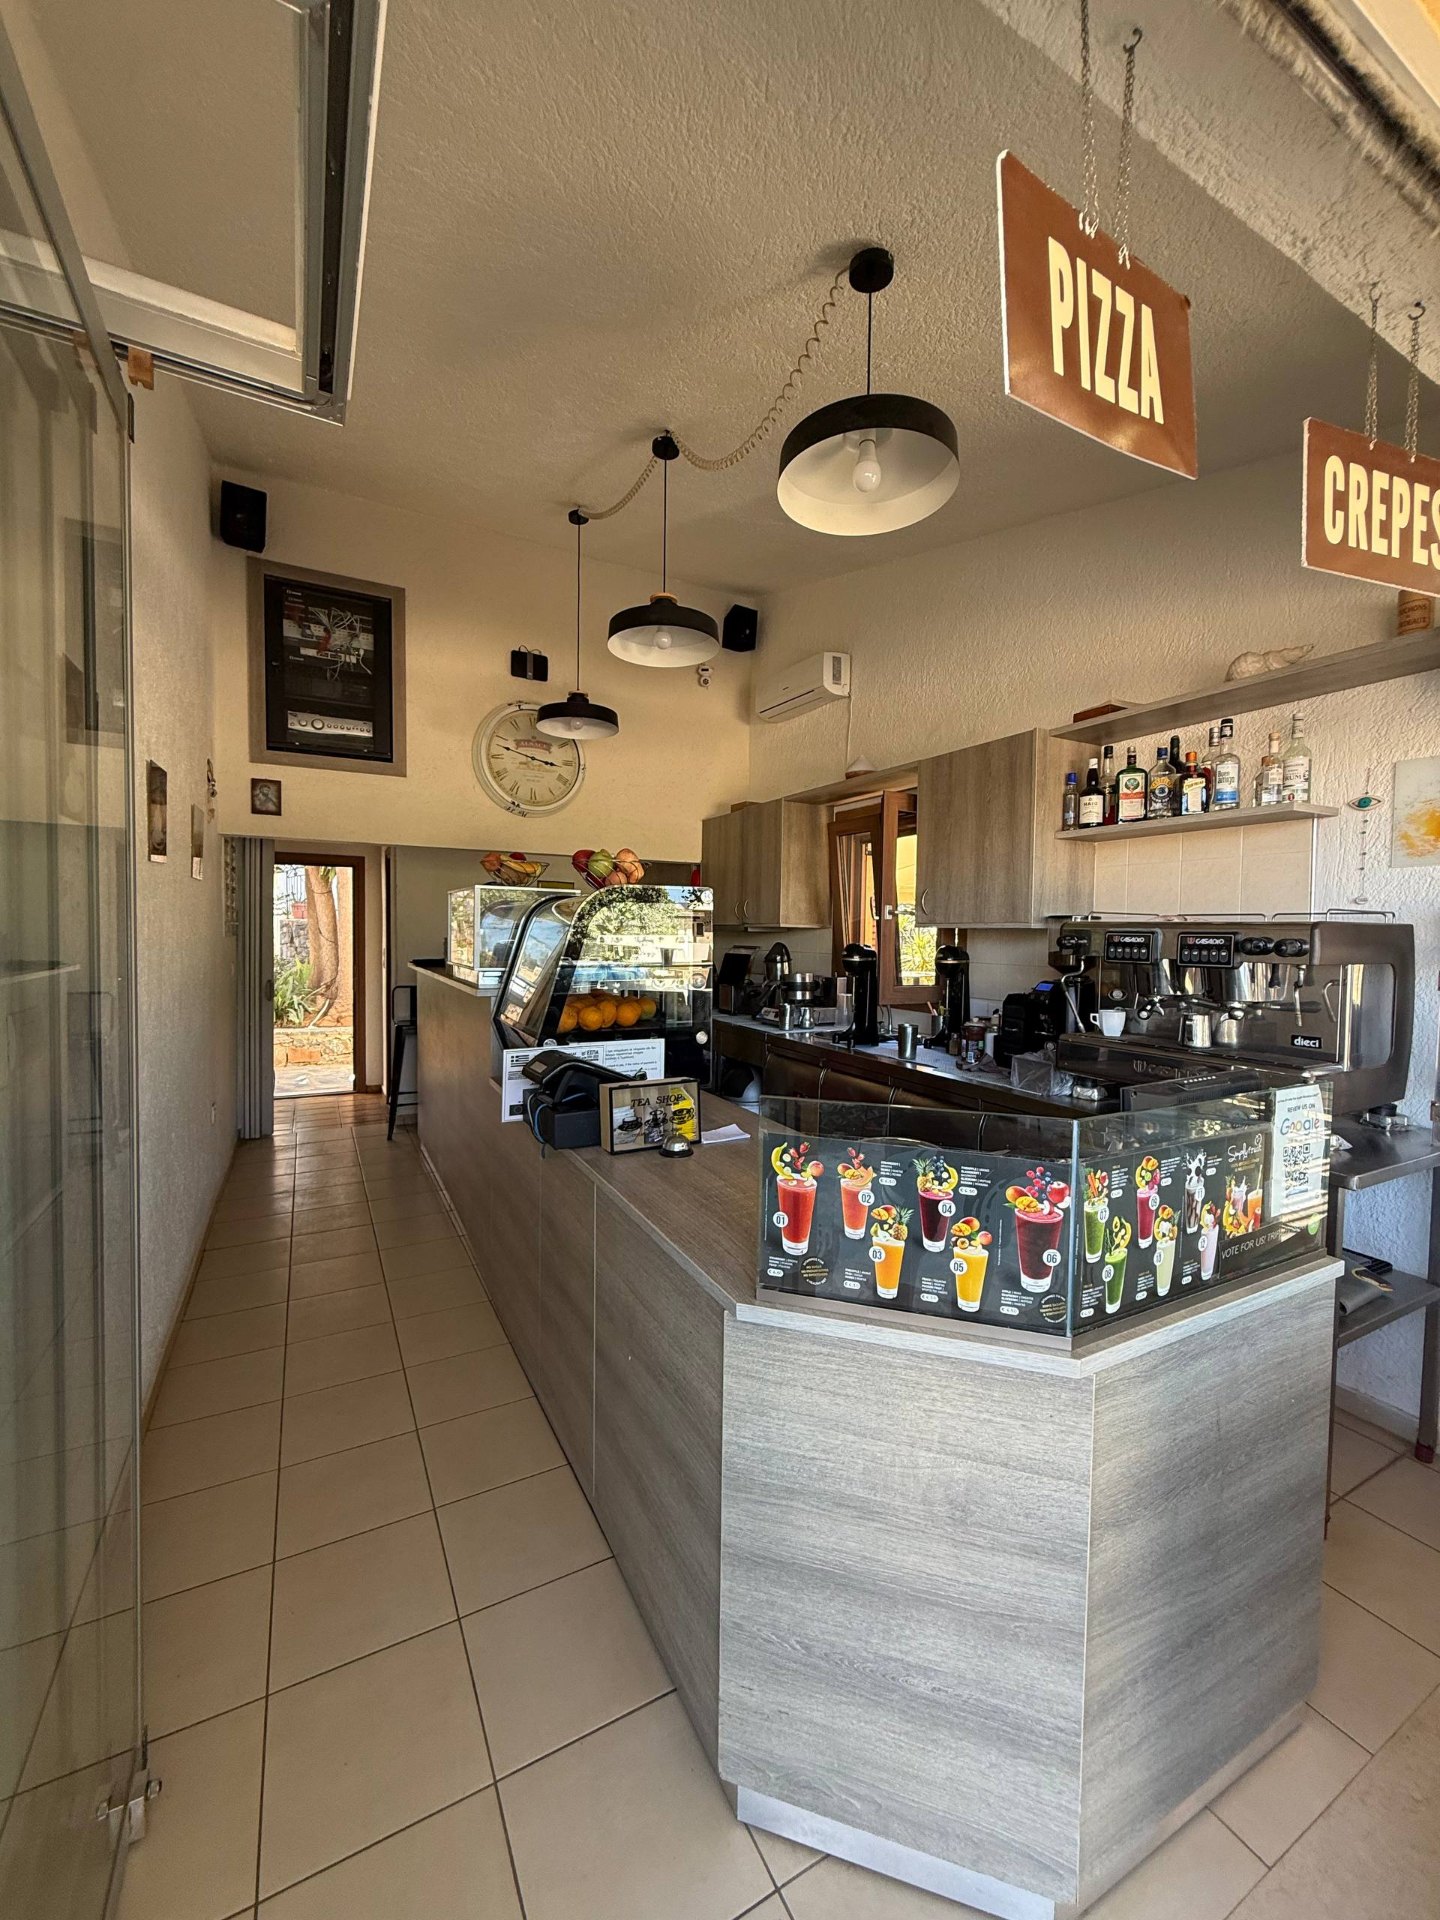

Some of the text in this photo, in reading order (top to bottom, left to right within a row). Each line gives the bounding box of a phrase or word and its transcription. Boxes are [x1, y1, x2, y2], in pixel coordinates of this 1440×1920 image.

[1047, 236, 1165, 425] PIZZA
[1293, 1036, 1319, 1048] dieci
[630, 1093, 683, 1108] TEA SHOP
[1280, 1117, 1320, 1136] Google
[861, 1193, 871, 1204] 02
[941, 1204, 952, 1214] 04
[776, 1215, 785, 1225] 01
[1099, 1210, 1107, 1220] 07
[1221, 1244, 1239, 1260] VOTE
[1240, 1239, 1254, 1252] FOR
[1255, 1236, 1267, 1247] US!
[872, 1249, 882, 1260] 03
[1046, 1253, 1057, 1264] 06
[953, 1262, 964, 1272] 05
[1104, 1268, 1112, 1279] 08
